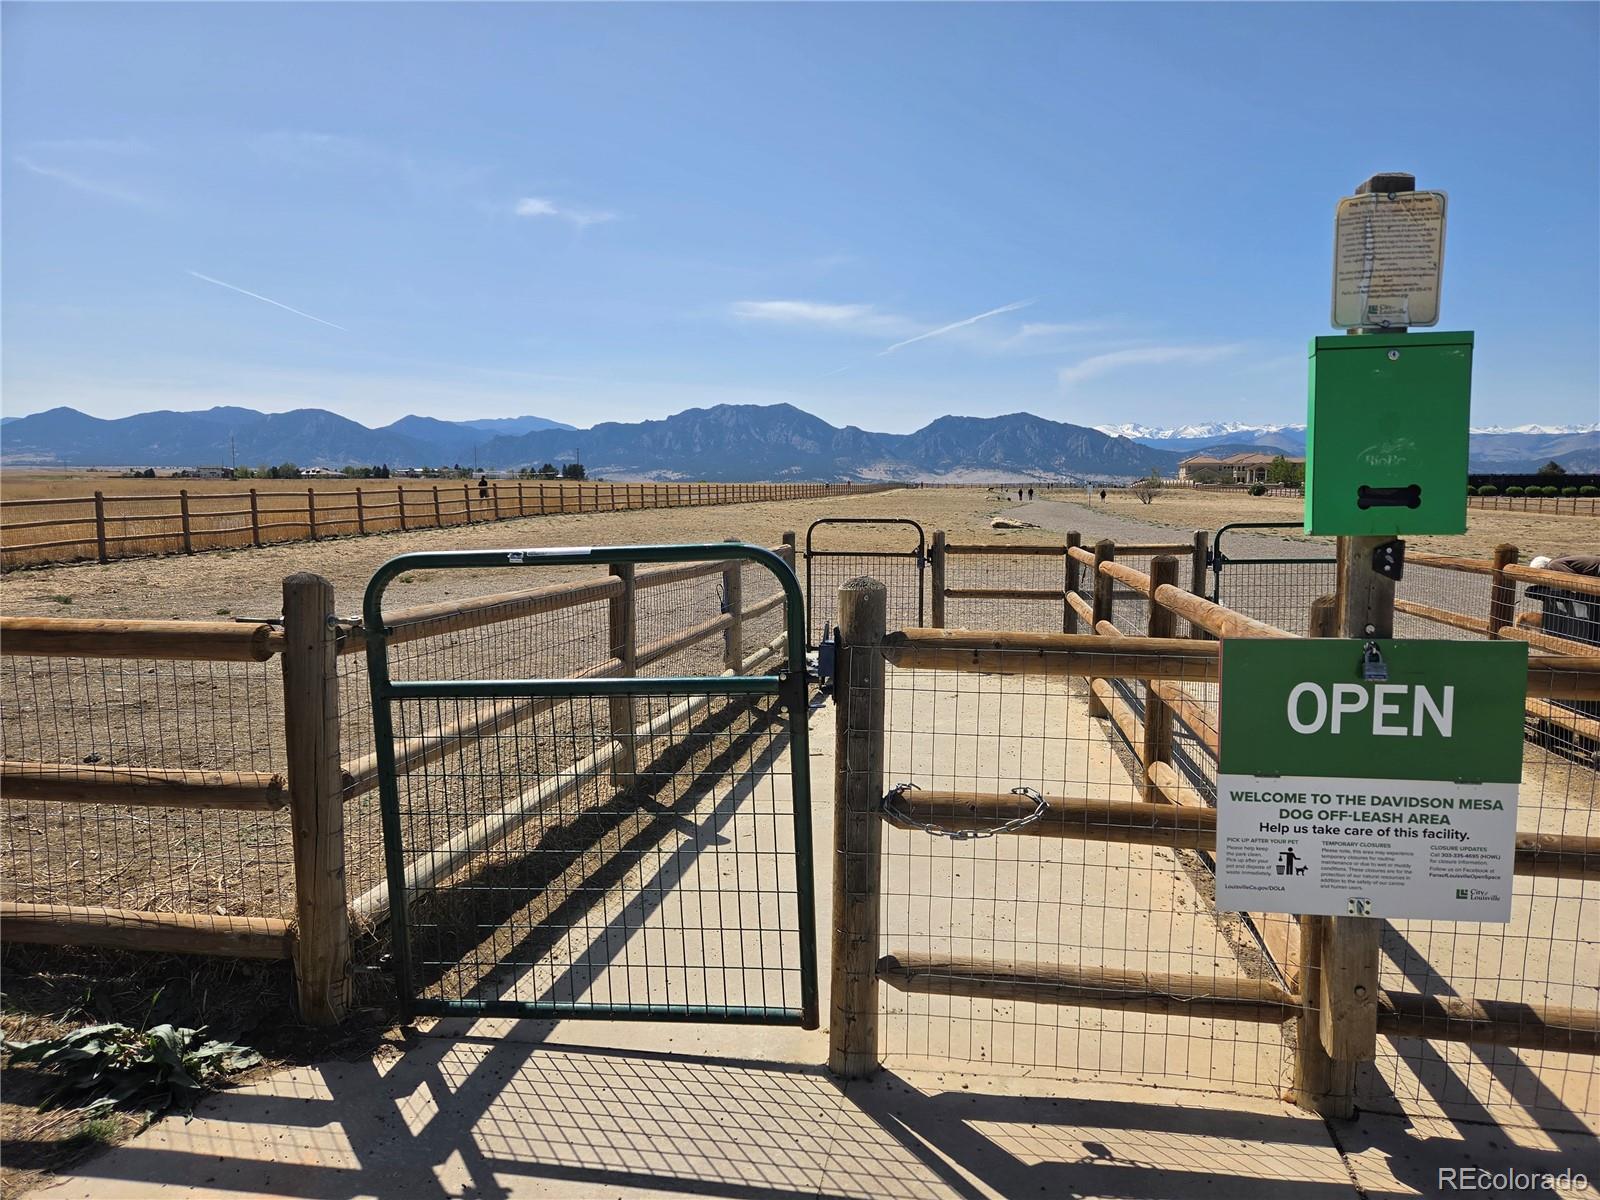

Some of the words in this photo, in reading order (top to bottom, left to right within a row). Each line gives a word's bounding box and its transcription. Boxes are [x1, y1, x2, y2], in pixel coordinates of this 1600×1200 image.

[1287, 682, 1454, 737] OPEN
[1229, 791, 1306, 804] WELCOME
[1311, 793, 1331, 805] TO
[1336, 795, 1366, 806] THE
[1371, 796, 1454, 809] DAVIDSON
[1459, 799, 1504, 810] MESA
[1280, 808, 1313, 820] DOG
[1318, 810, 1403, 824] OFF-LEASH
[1408, 813, 1451, 825] AREA
[1259, 822, 1289, 835] Help
[1294, 826, 1308, 834] us
[1312, 824, 1340, 835] take
[1344, 828, 1373, 836] care
[1377, 827, 1391, 837] of
[1394, 828, 1418, 838] this
[1423, 828, 1470, 842] facility.
